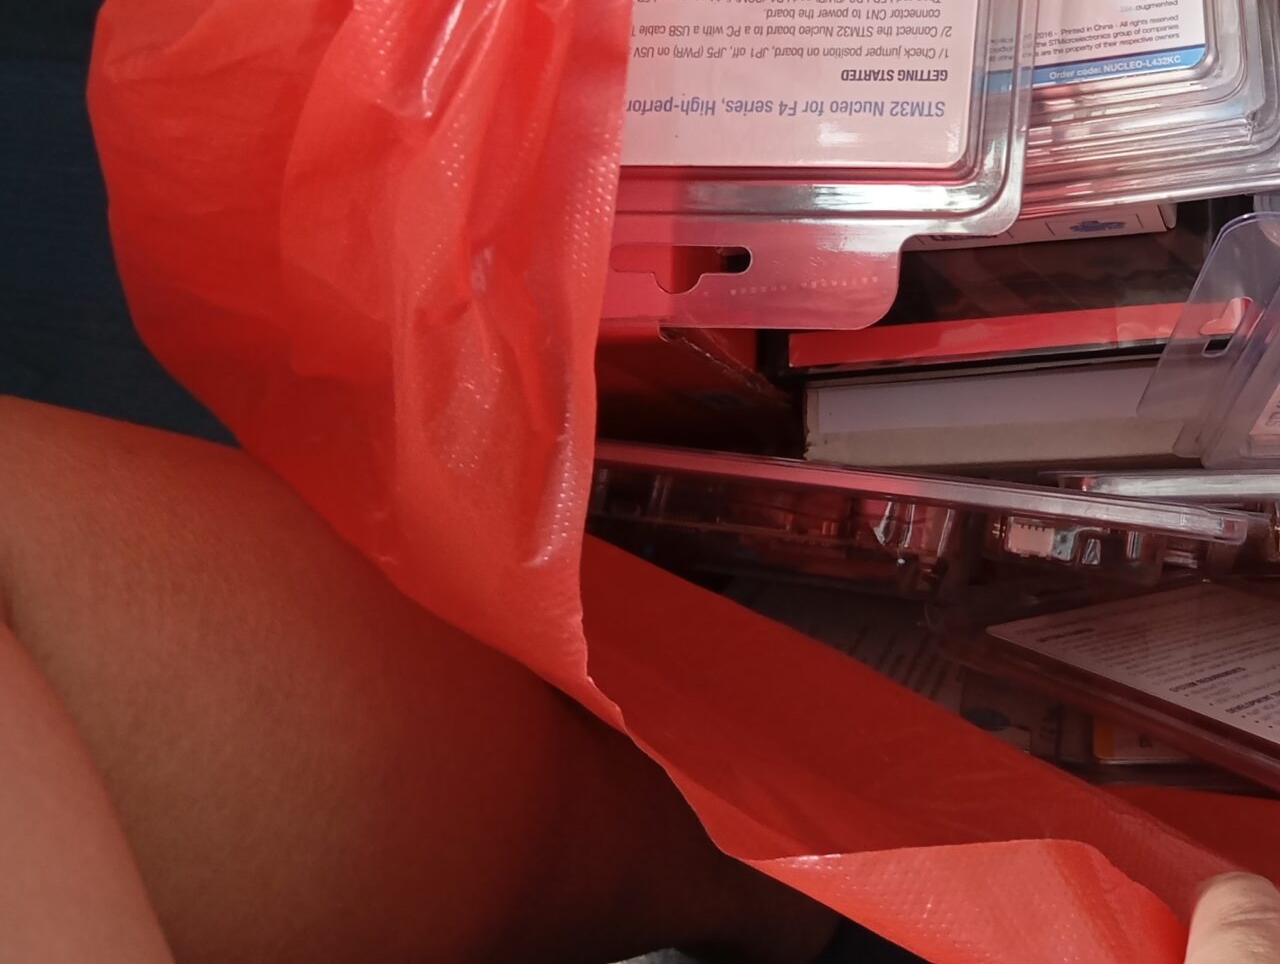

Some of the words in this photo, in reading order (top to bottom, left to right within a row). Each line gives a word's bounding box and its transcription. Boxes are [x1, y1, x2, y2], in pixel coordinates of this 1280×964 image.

[764, 8, 795, 19] board.
[799, 9, 814, 19] the
[818, 7, 849, 19] power
[852, 9, 861, 19] to
[866, 9, 886, 20] CN1
[890, 9, 941, 20] connector
[639, 25, 666, 36] cable
[669, 25, 690, 36] USB
[694, 25, 699, 35] a
[703, 25, 723, 36] with
[727, 25, 741, 37] PC
[745, 25, 750, 35] a
[754, 25, 763, 36] to
[766, 25, 795, 37] board
[799, 25, 833, 36] Nucleo
[1060, 25, 1085, 36] Printed
[1094, 22, 1114, 31] China
[1129, 18, 1148, 28] rights
[1149, 15, 1179, 23] reserved
[837, 26, 874, 37] STM32
[877, 26, 893, 37] the
[896, 26, 937, 37] Connect
[941, 26, 952, 37] 2/
[1049, 32, 1112, 47] STMicroelectronics
[1112, 29, 1133, 39] group
[1142, 24, 1179, 35] companies
[1064, 42, 1093, 54] property
[1101, 40, 1118, 49] their
[1120, 37, 1155, 47] respective
[1155, 32, 1179, 42] owners
[633, 46, 654, 57] U5V
[658, 47, 670, 56] on
[673, 45, 703, 58] (PWR)
[707, 47, 727, 58] JP5
[730, 46, 745, 58] off,
[750, 47, 769, 58] JP1
[772, 46, 803, 58] board,
[807, 47, 819, 55] on
[823, 46, 862, 59] position
[865, 46, 901, 58] jumper
[905, 48, 936, 59] Check
[938, 48, 949, 58] 1/
[841, 69, 894, 81] STARTED
[898, 69, 948, 81] GETTING
[1049, 70, 1075, 80] Order
[1076, 66, 1102, 77] code:
[627, 97, 715, 116] High-perfor
[721, 98, 773, 116] series,
[779, 100, 798, 115] F4
[802, 101, 824, 116] for
[830, 101, 884, 116] Nucleo
[890, 101, 945, 117] STM32
